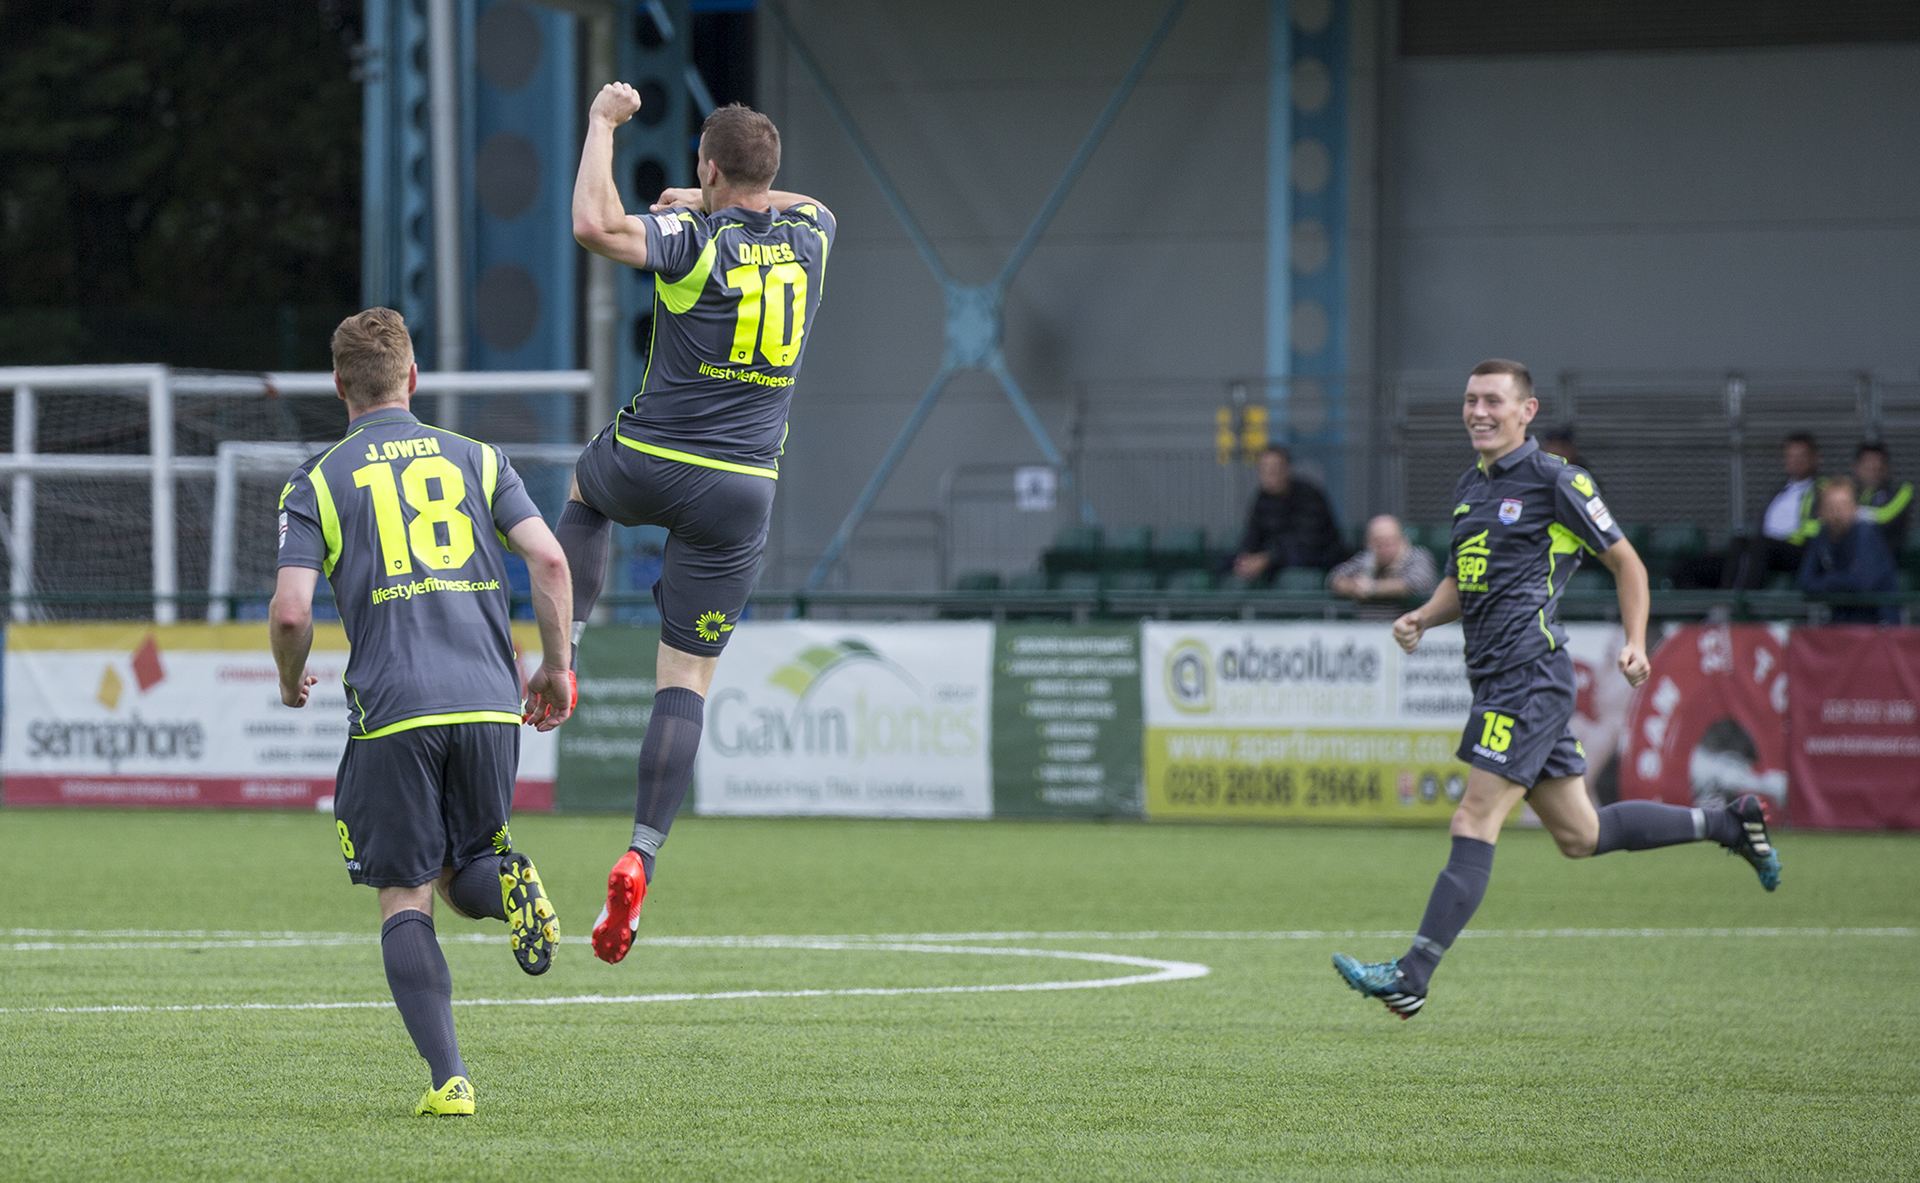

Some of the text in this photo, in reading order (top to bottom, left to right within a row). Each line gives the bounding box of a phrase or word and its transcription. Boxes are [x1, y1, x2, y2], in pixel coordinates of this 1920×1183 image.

[726, 262, 808, 367] 10
[365, 437, 441, 462] J.OWEN
[352, 455, 476, 577] 18
[371, 576, 500, 605] lifestylefitness.co.uk
[1456, 555, 1488, 583] gap
[1218, 636, 1380, 683] absolute
[27, 708, 205, 773] semaphore
[708, 686, 979, 764] Gavin Jones
[1480, 711, 1515, 752] 15
